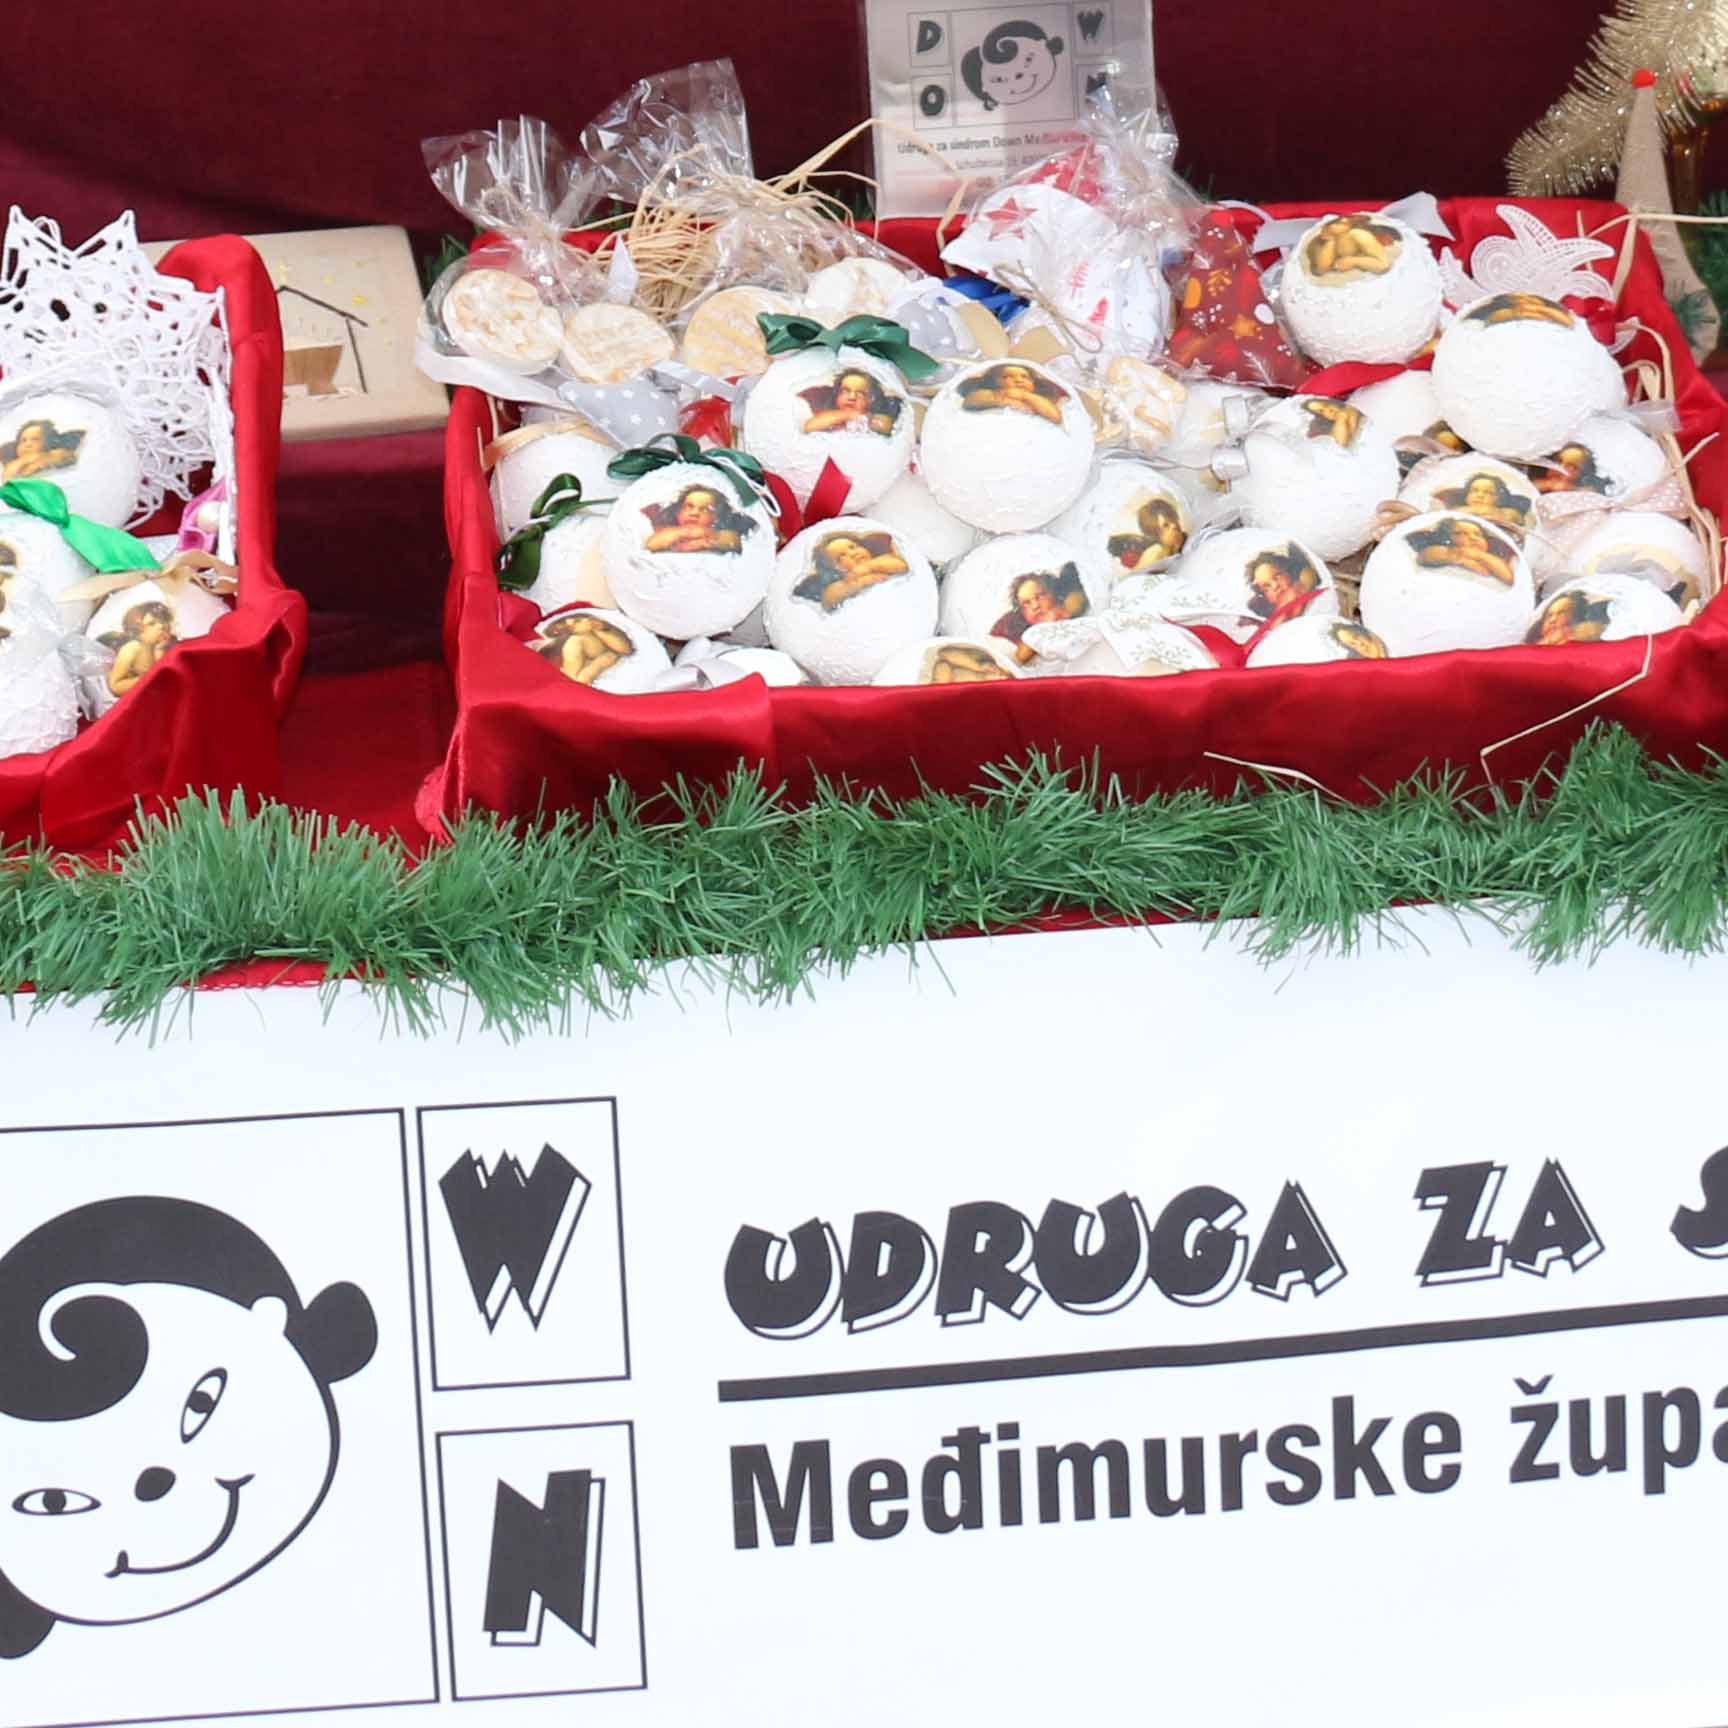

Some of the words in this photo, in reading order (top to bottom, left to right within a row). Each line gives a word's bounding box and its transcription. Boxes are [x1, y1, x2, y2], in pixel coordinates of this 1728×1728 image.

[916, 20, 943, 54] D
[437, 1141, 592, 1336] W
[723, 1178, 1348, 1341] UDRUGA
[1413, 1158, 1606, 1287] ZA
[482, 1468, 607, 1649] N
[728, 1394, 1463, 1551] Međimurske
